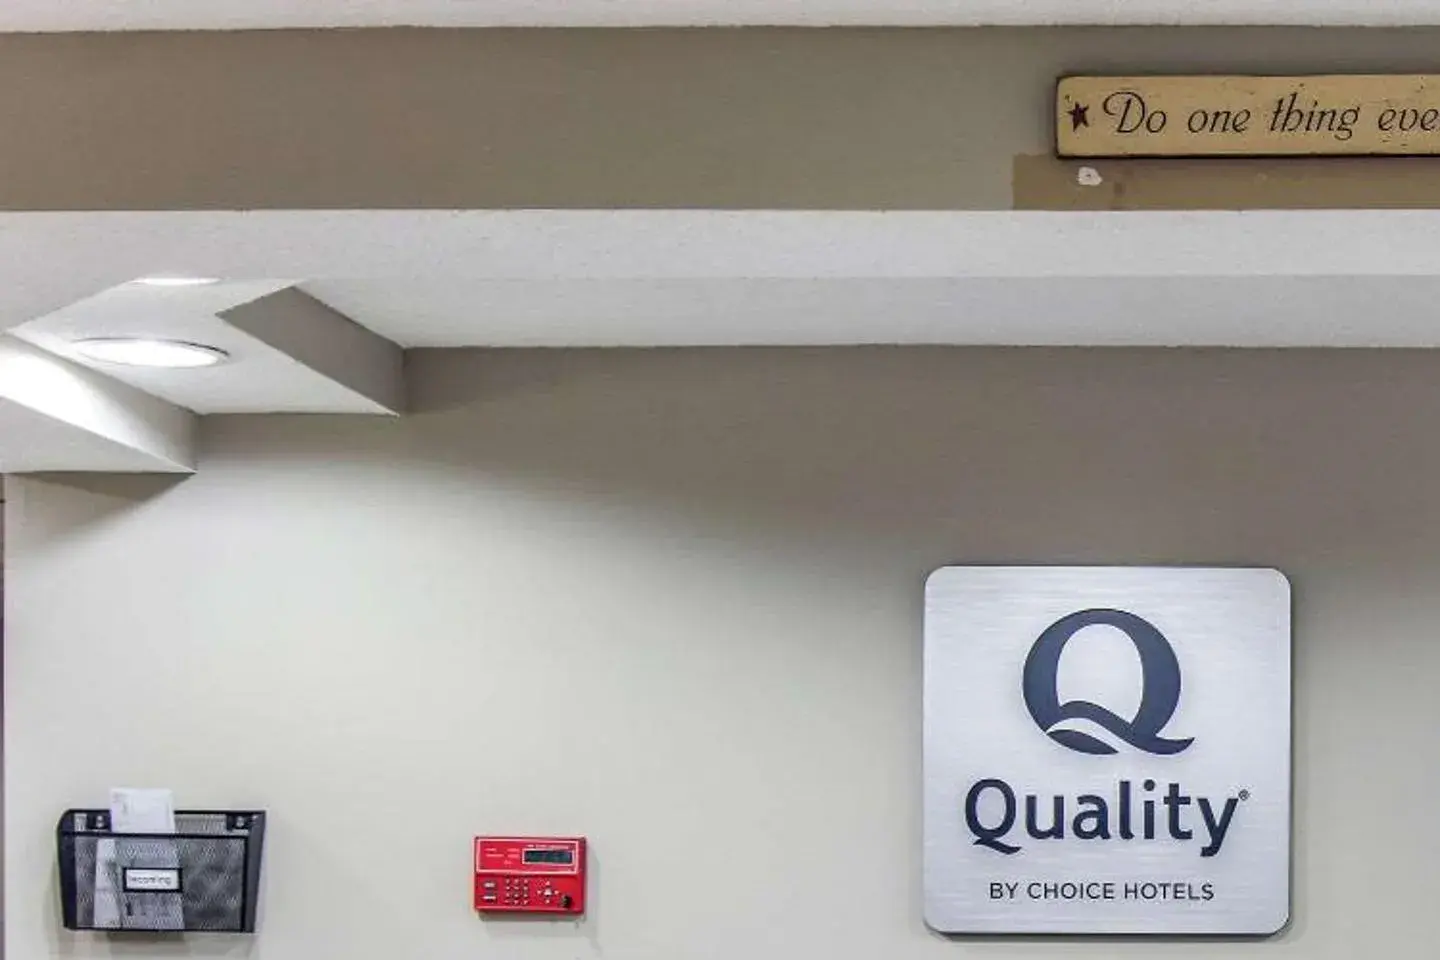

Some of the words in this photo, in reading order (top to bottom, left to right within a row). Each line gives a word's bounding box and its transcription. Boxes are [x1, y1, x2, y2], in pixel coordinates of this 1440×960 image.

[1102, 91, 1167, 134] Do
[1187, 104, 1251, 133] one
[1269, 92, 1359, 141] thing
[1022, 608, 1195, 755] Q
[964, 778, 1240, 857] Quality
[989, 882, 1019, 900] BY
[1027, 882, 1115, 900] CHOICE
[1124, 882, 1215, 901] HOTELS
